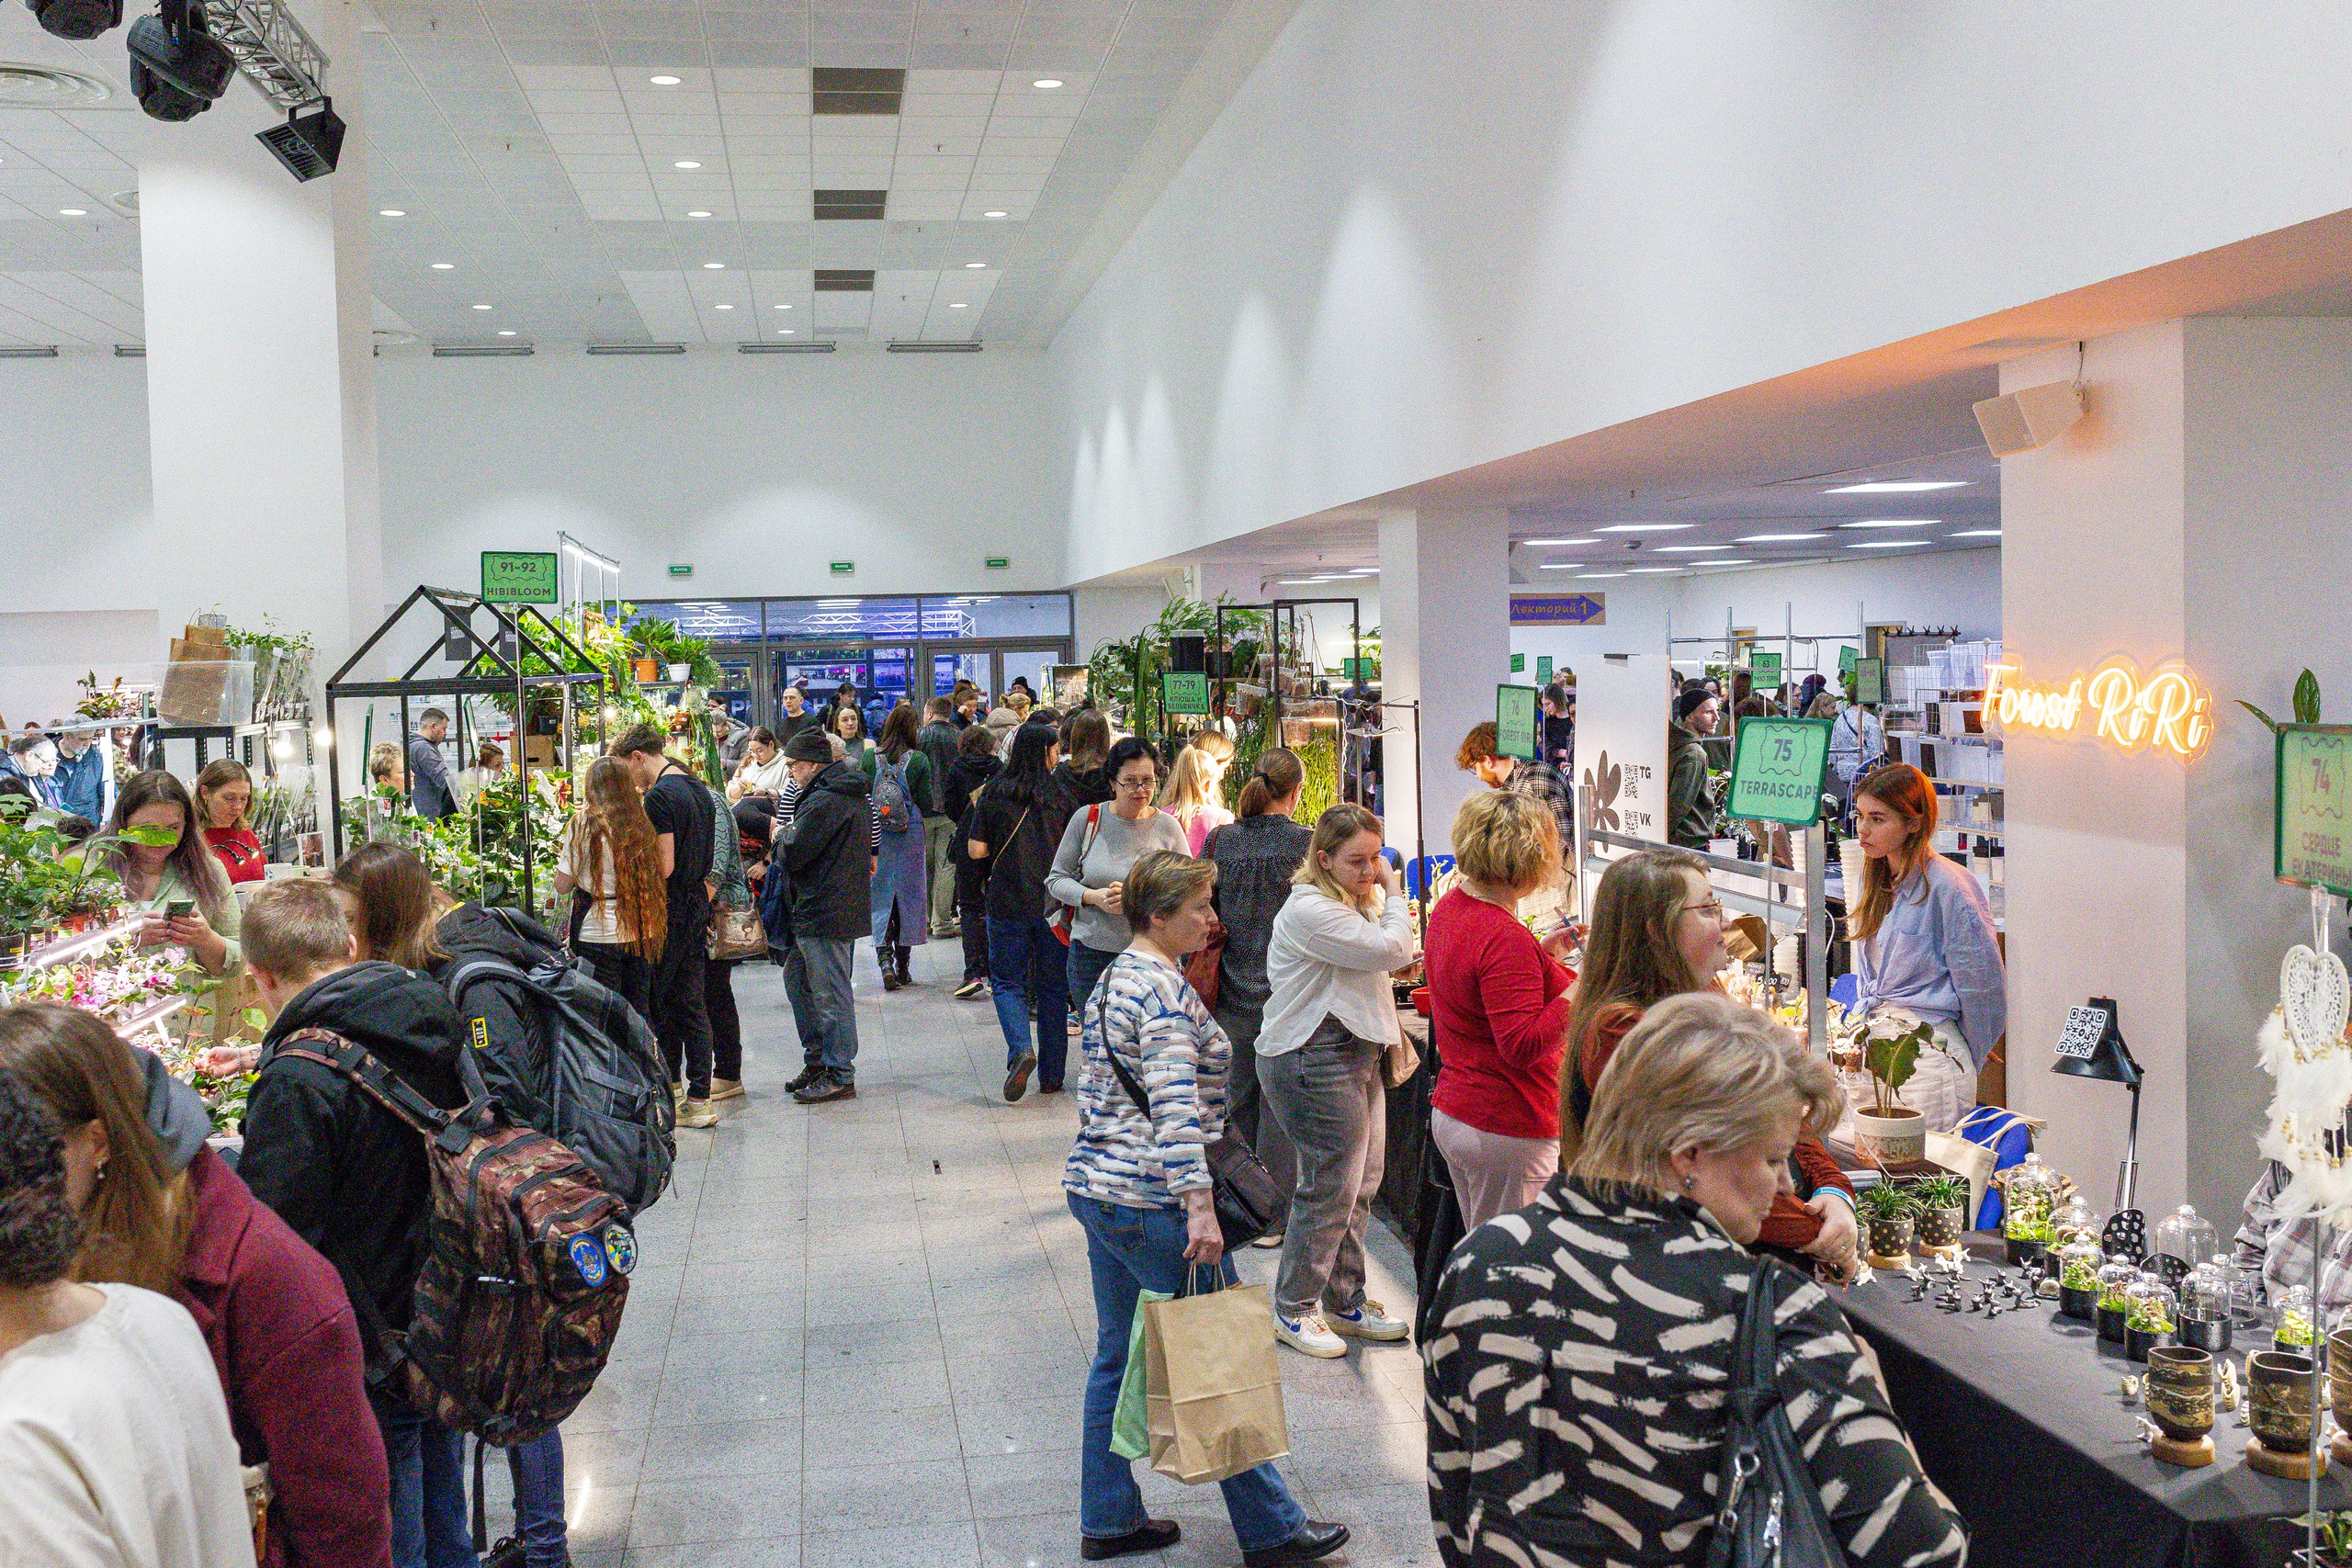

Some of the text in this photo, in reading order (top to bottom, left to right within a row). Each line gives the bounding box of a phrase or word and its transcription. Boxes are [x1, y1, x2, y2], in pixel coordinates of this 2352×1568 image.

[500, 561, 537, 573] 91-92
[486, 587, 551, 596] HIBIBLOOM
[1510, 602, 1588, 617] Лекторий 1
[1172, 680, 1196, 690] 77-79
[2087, 667, 2211, 754] RiRi
[1773, 739, 1793, 761] 75
[1639, 765, 1652, 780] TG
[2312, 758, 2331, 795] 74
[1639, 812, 1652, 827] VK
